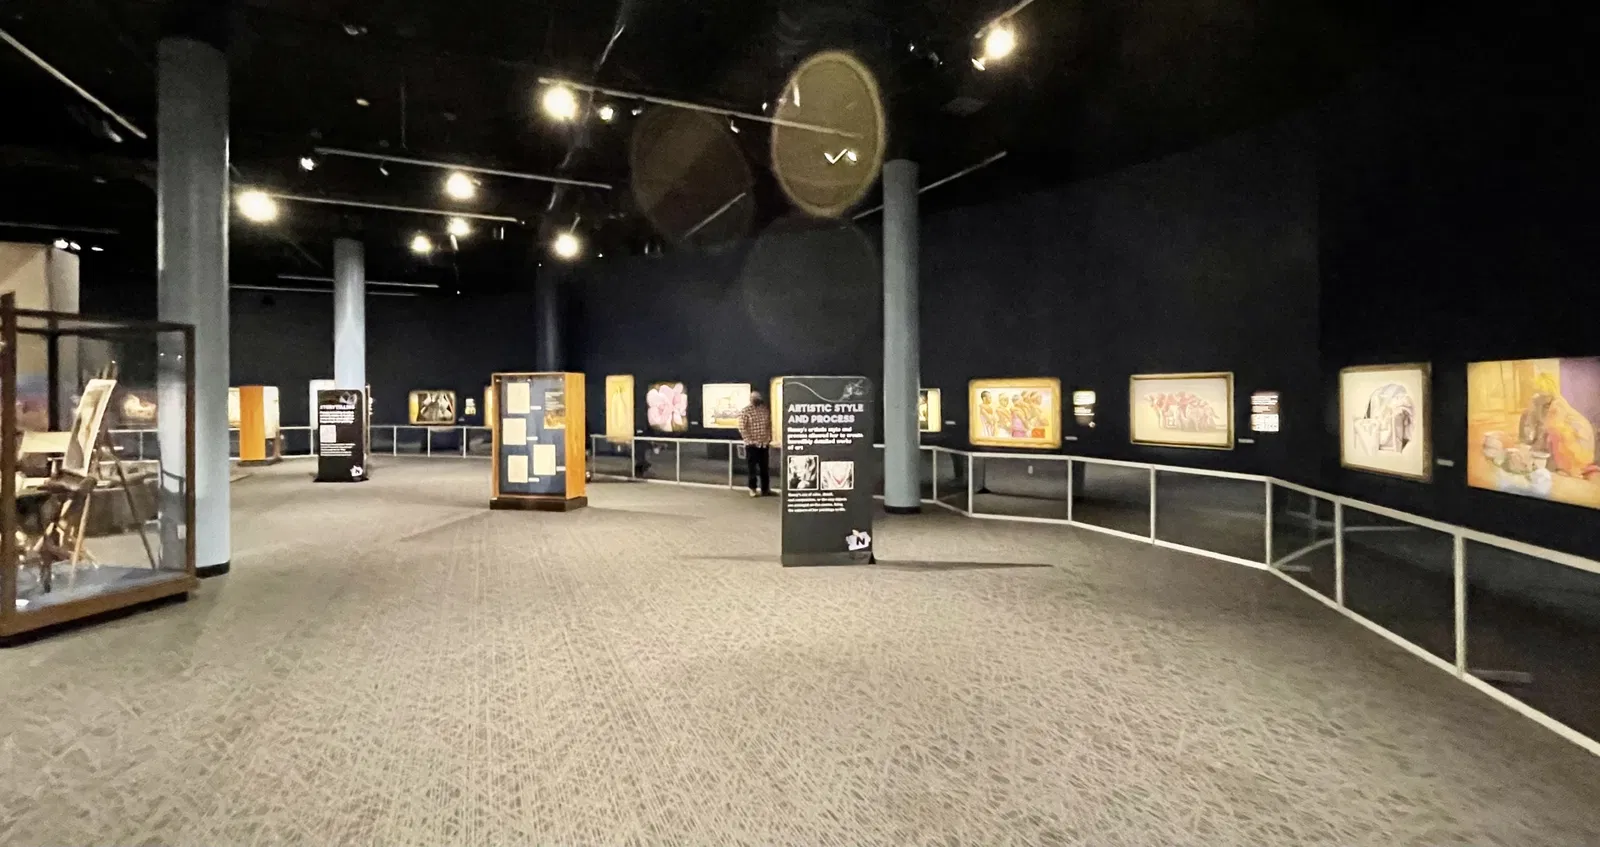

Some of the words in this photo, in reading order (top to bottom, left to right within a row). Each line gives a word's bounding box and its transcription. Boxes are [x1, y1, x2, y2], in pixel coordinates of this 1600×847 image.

[788, 403, 832, 412] ARTISTIC
[834, 403, 864, 412] STYLE
[788, 415, 809, 424] AND
[810, 414, 855, 423] PROCESS
[856, 537, 865, 545] N
